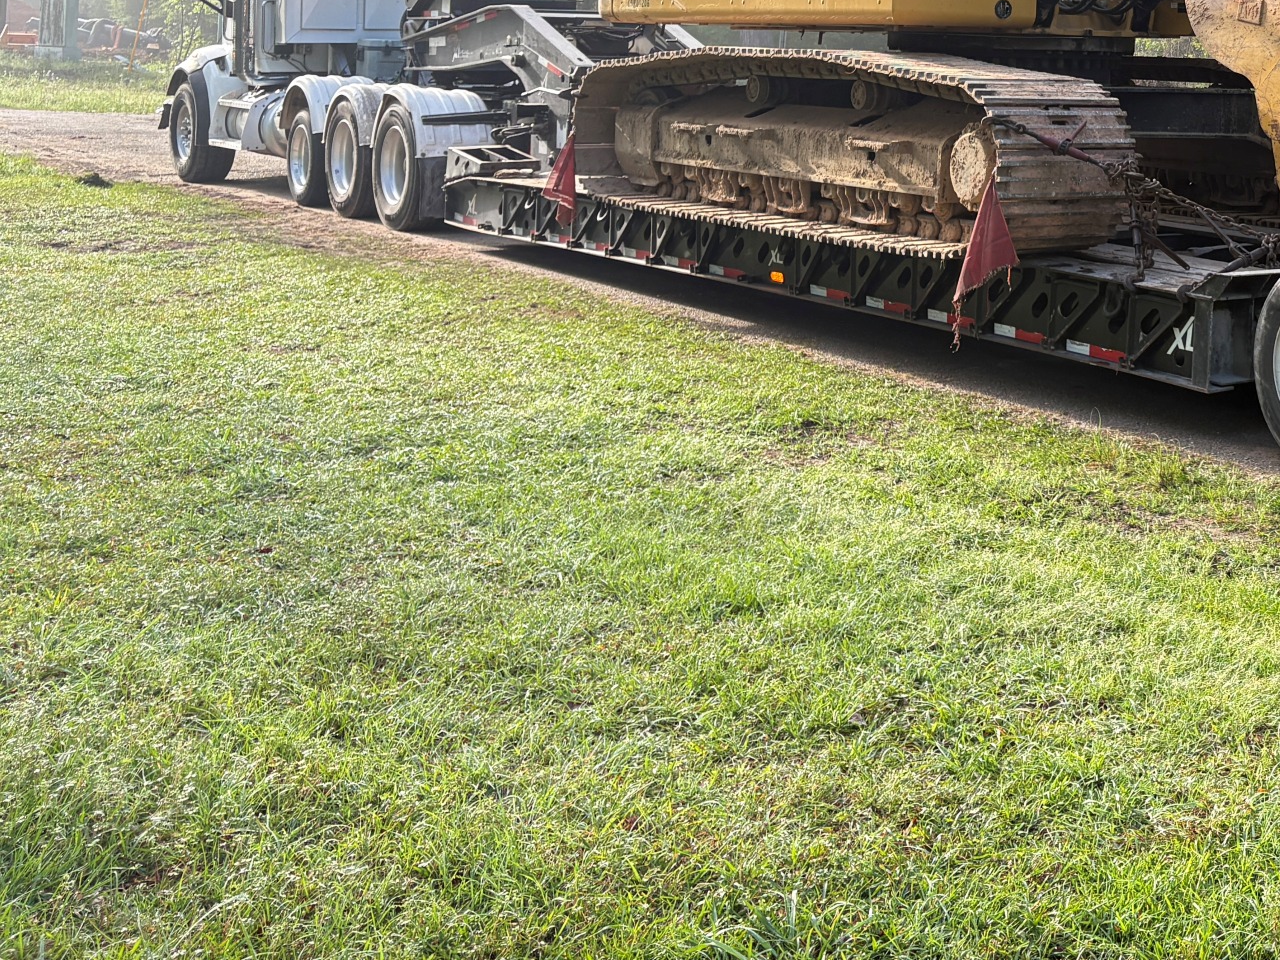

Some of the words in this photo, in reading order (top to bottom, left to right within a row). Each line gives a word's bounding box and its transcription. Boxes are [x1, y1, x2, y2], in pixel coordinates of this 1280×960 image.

[465, 193, 478, 217] XL
[767, 245, 784, 267] XL
[1166, 315, 1196, 356] XL
